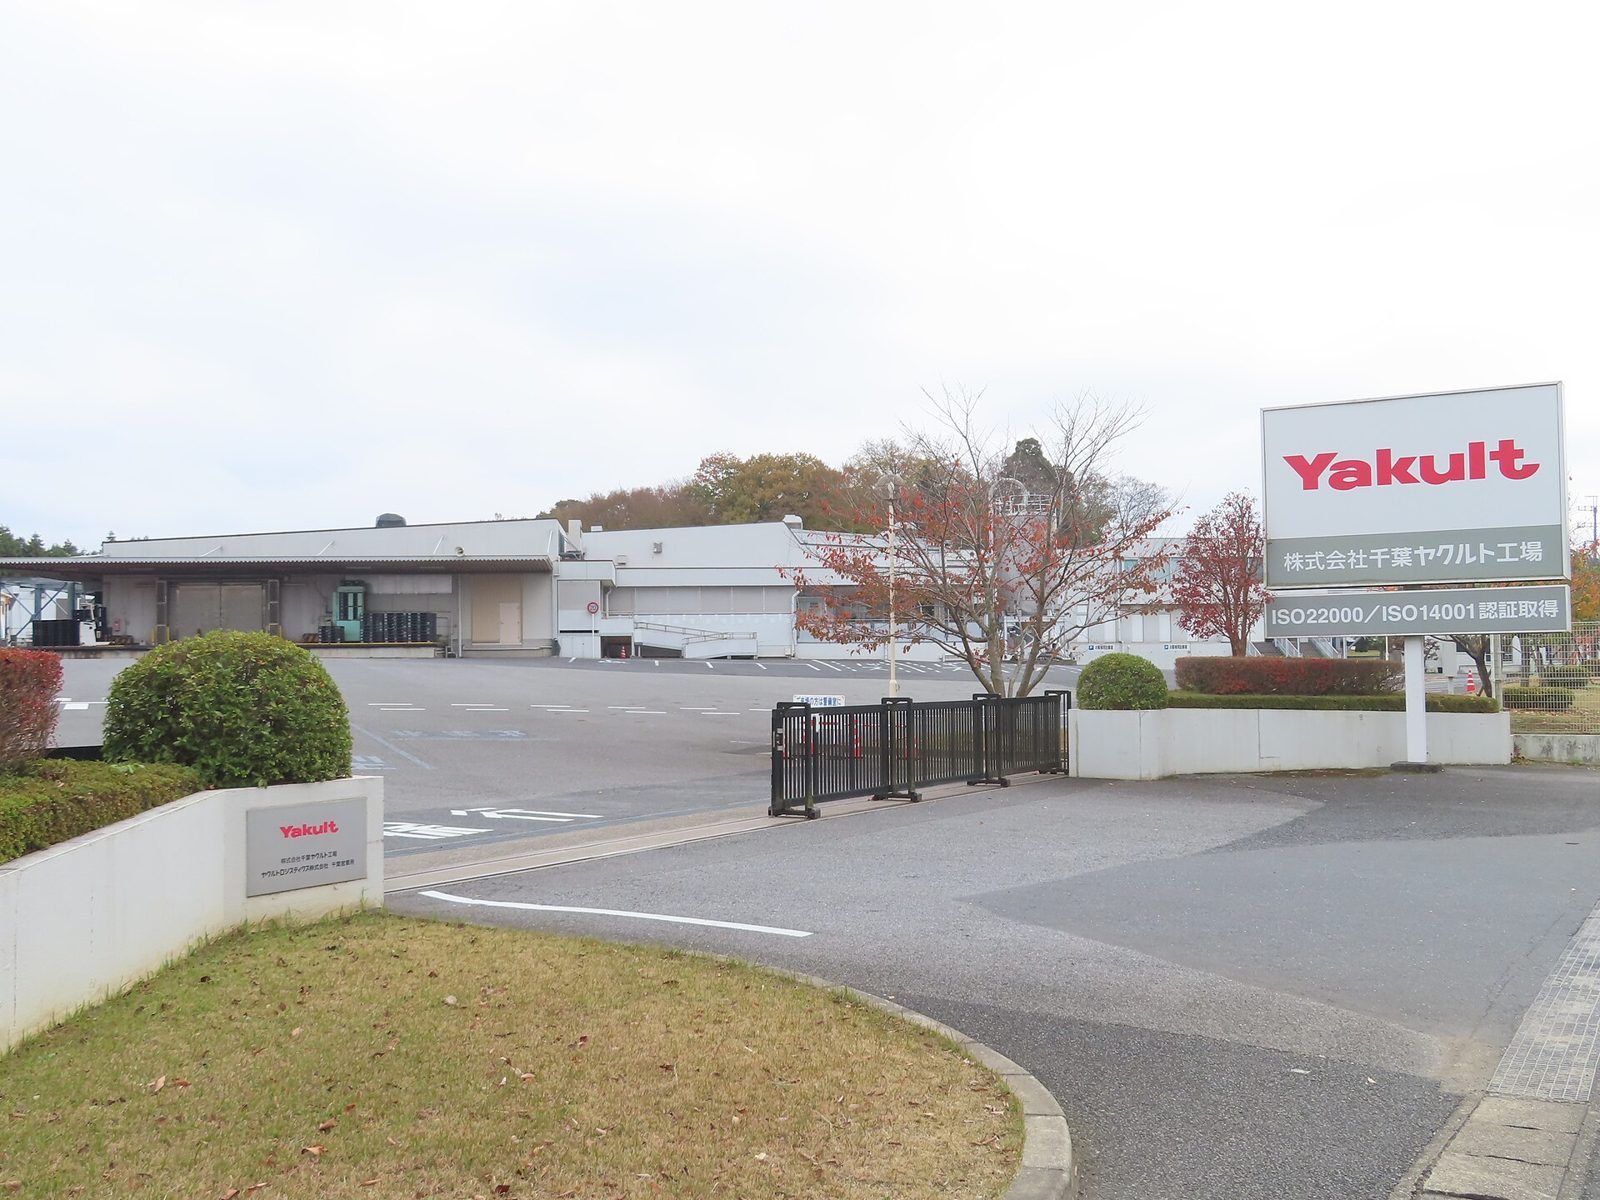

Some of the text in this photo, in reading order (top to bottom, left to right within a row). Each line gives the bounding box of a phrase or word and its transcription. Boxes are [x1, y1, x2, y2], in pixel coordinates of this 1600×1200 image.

[1282, 439, 1540, 491] Yakult
[1283, 541, 1543, 572] 株式会社千葉ヤクルト工場
[280, 820, 339, 839] Yakult
